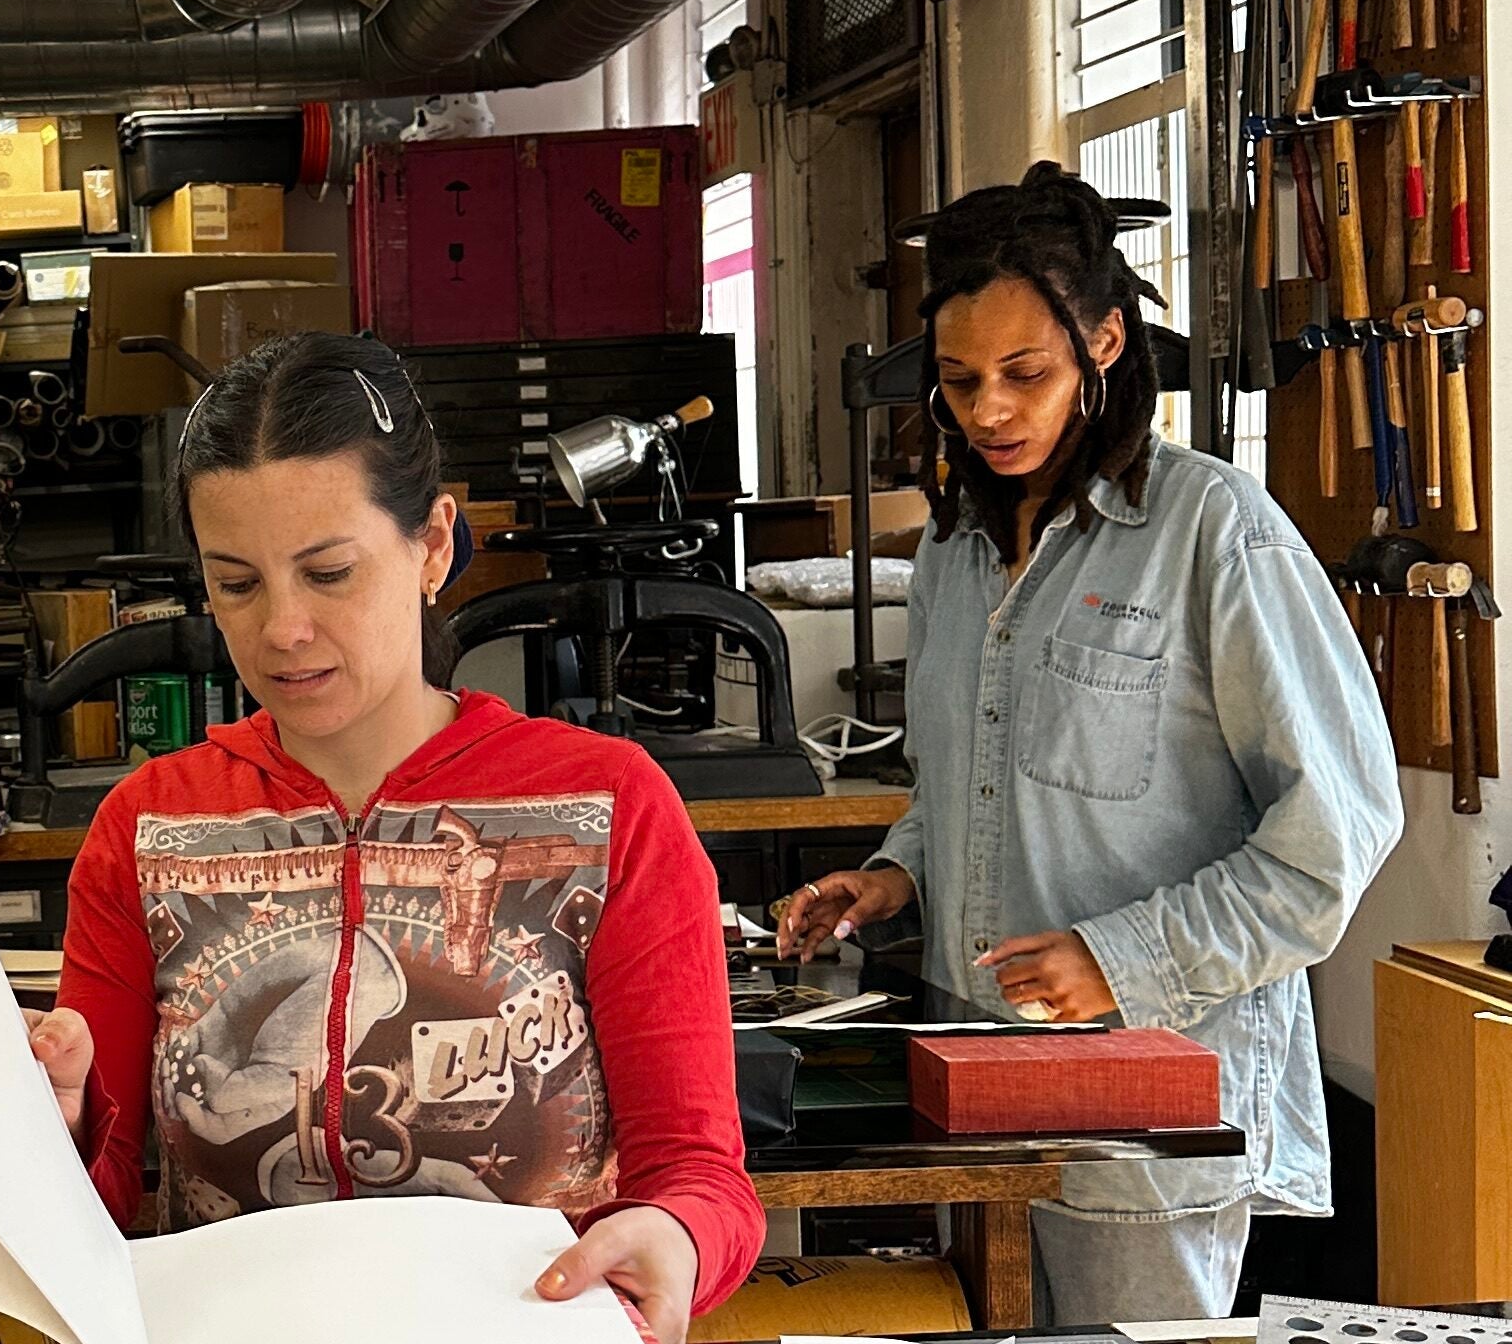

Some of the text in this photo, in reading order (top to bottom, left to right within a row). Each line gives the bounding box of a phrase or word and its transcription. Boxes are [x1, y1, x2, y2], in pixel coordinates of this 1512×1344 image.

[702, 83, 738, 175] EXIT
[584, 187, 641, 244] FRAGILE
[427, 989, 575, 1101] LUCK
[288, 1064, 422, 1189] 13
